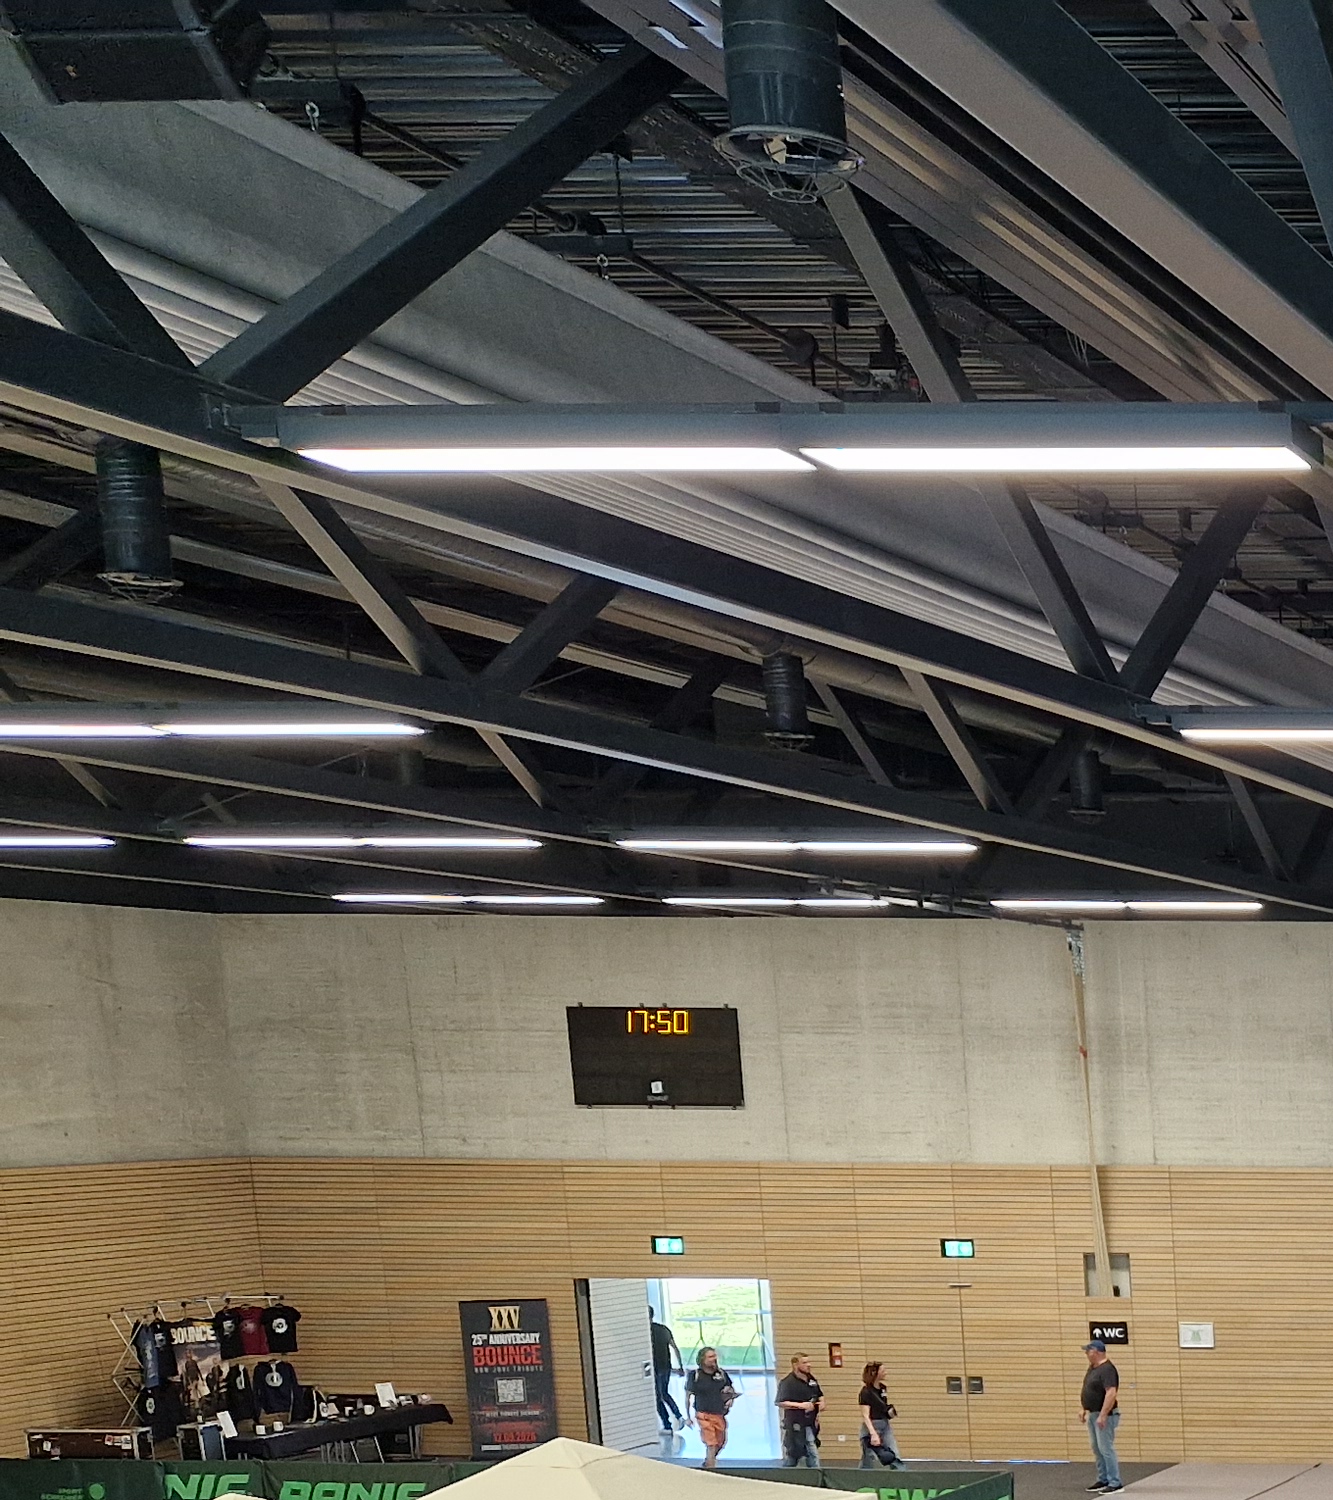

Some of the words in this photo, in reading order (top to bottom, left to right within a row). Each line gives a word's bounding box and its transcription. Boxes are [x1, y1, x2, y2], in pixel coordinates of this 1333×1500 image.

[627, 1010, 690, 1034] 17:50
[488, 1306, 521, 1331] XXV
[170, 1326, 217, 1345] BOUNCE
[489, 1333, 540, 1345] ANNIVERSARY
[1103, 1327, 1125, 1338] WC
[473, 1345, 543, 1366] BOUNCE
